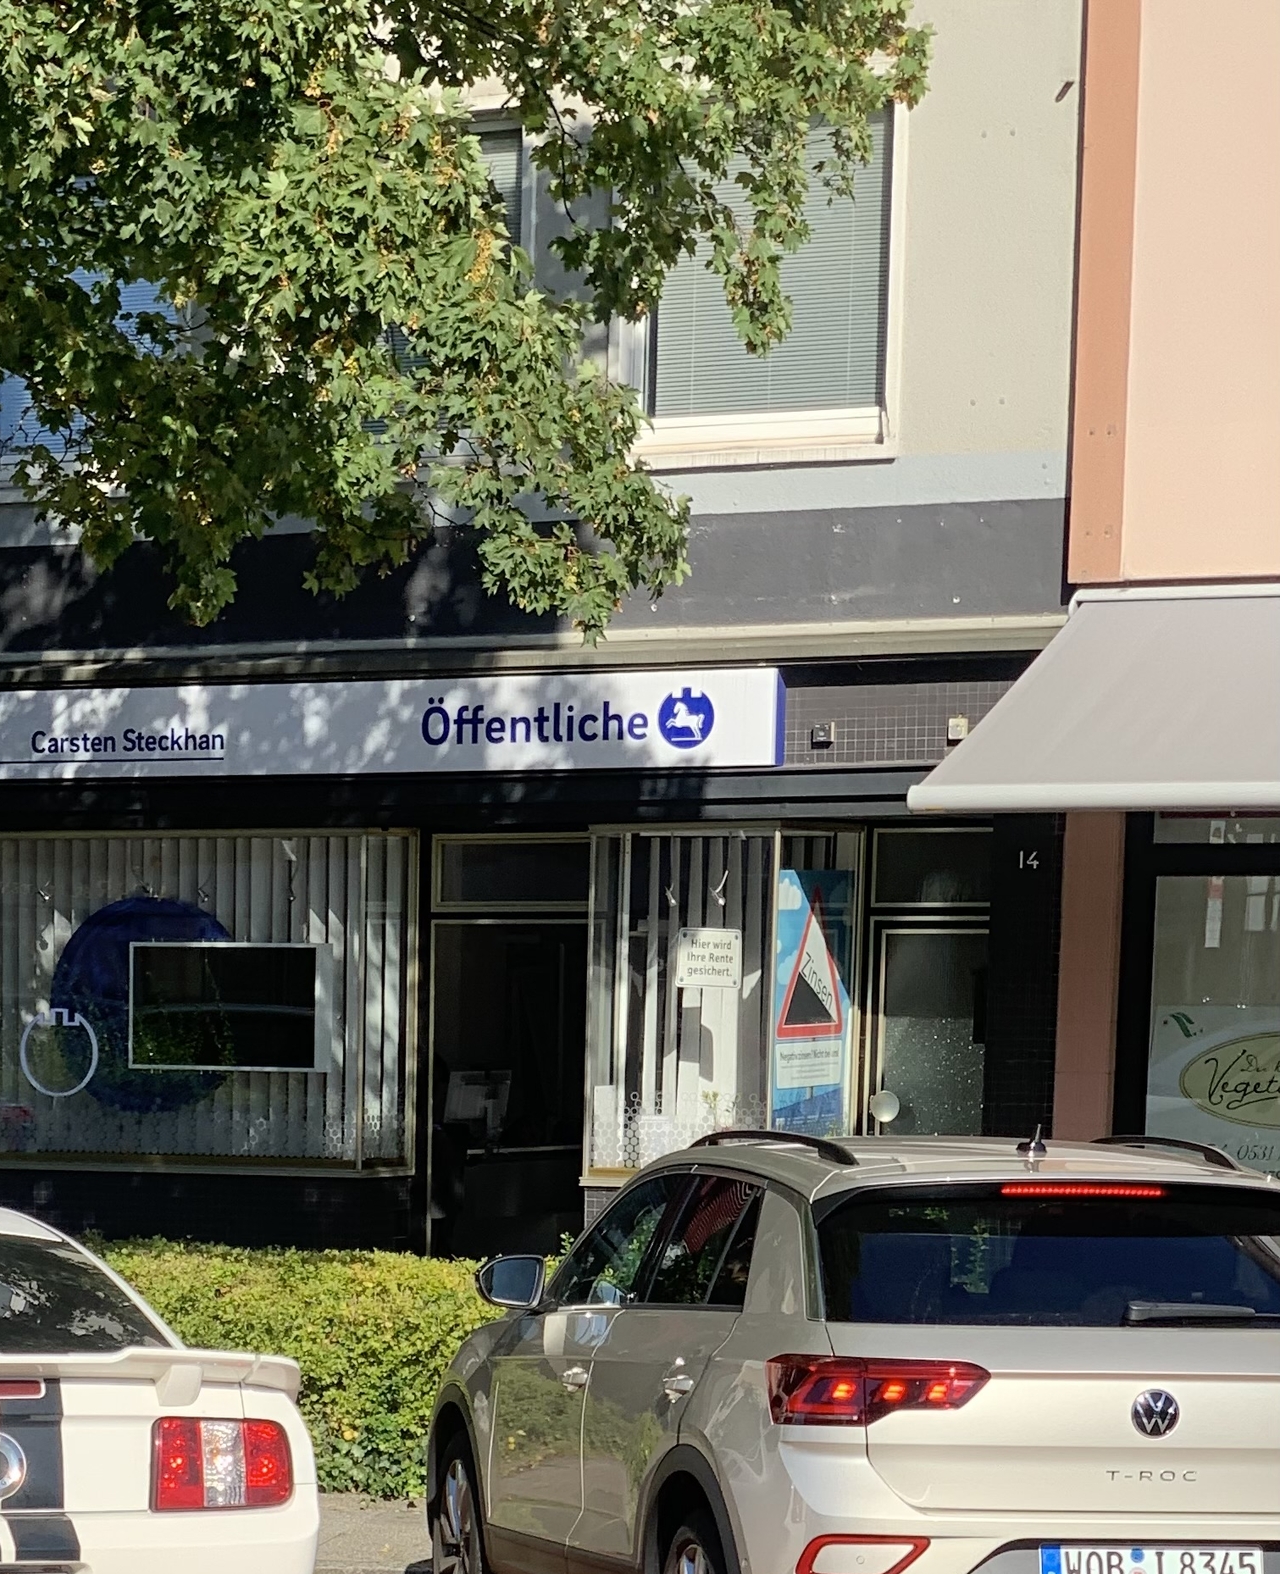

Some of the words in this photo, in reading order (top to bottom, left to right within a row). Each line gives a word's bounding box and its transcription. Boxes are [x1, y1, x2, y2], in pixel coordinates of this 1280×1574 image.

[421, 696, 649, 746] Öffentliche
[31, 730, 116, 754] Carsten
[122, 727, 225, 752] Steckhan
[1019, 850, 1040, 869] 14
[691, 938, 711, 949] Hier
[713, 939, 732, 950] wird
[687, 951, 706, 962] Ihre
[709, 952, 734, 964] Rente
[686, 965, 733, 978] gesichert.
[801, 951, 833, 1011] Zinsen
[1237, 1144, 1274, 1161] 0531
[1106, 1470, 1197, 1482] T-ROC
